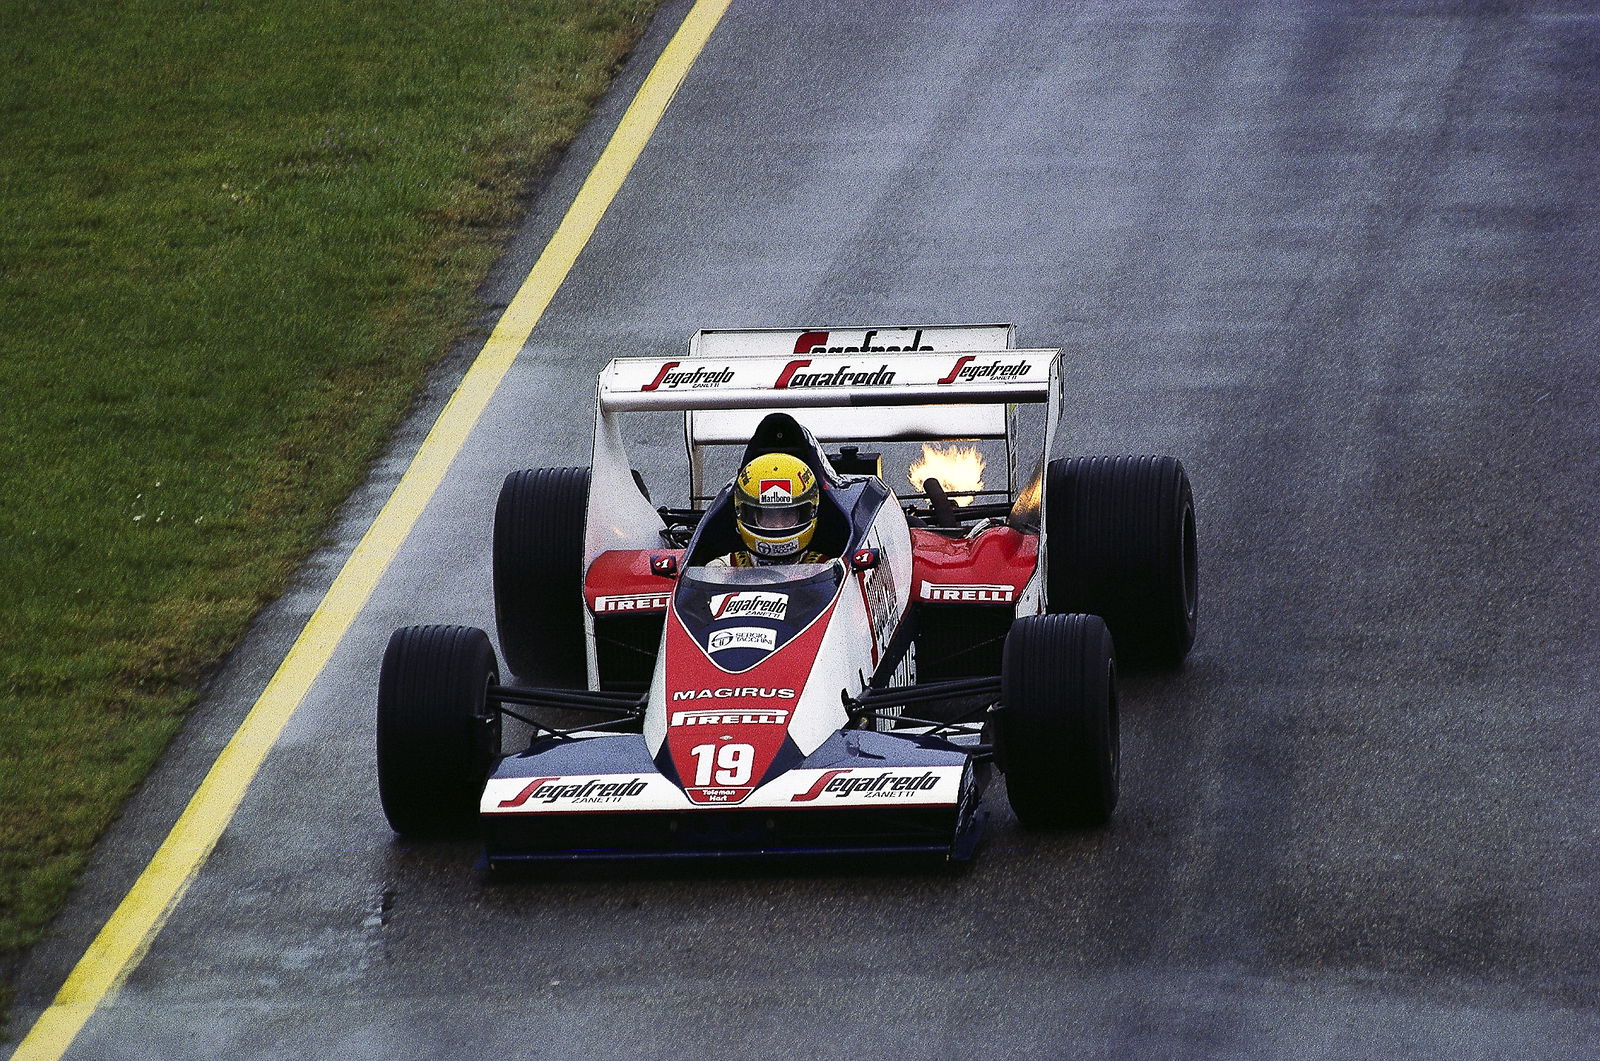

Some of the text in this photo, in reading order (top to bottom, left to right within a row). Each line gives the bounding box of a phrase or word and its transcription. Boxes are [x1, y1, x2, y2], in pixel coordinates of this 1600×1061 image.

[640, 361, 735, 392] Segafredo
[937, 355, 1032, 384] Segafredo
[761, 491, 791, 503] Marlboro
[920, 579, 1015, 602] PIRELLI
[712, 592, 788, 619] Segafredo
[673, 687, 796, 701] MAGIRUS
[670, 708, 789, 727] PIRELLI
[691, 743, 755, 786] 19
[497, 777, 649, 808] Segafredo
[791, 769, 941, 802] Segafredo
[571, 796, 622, 804] ZANETTI
